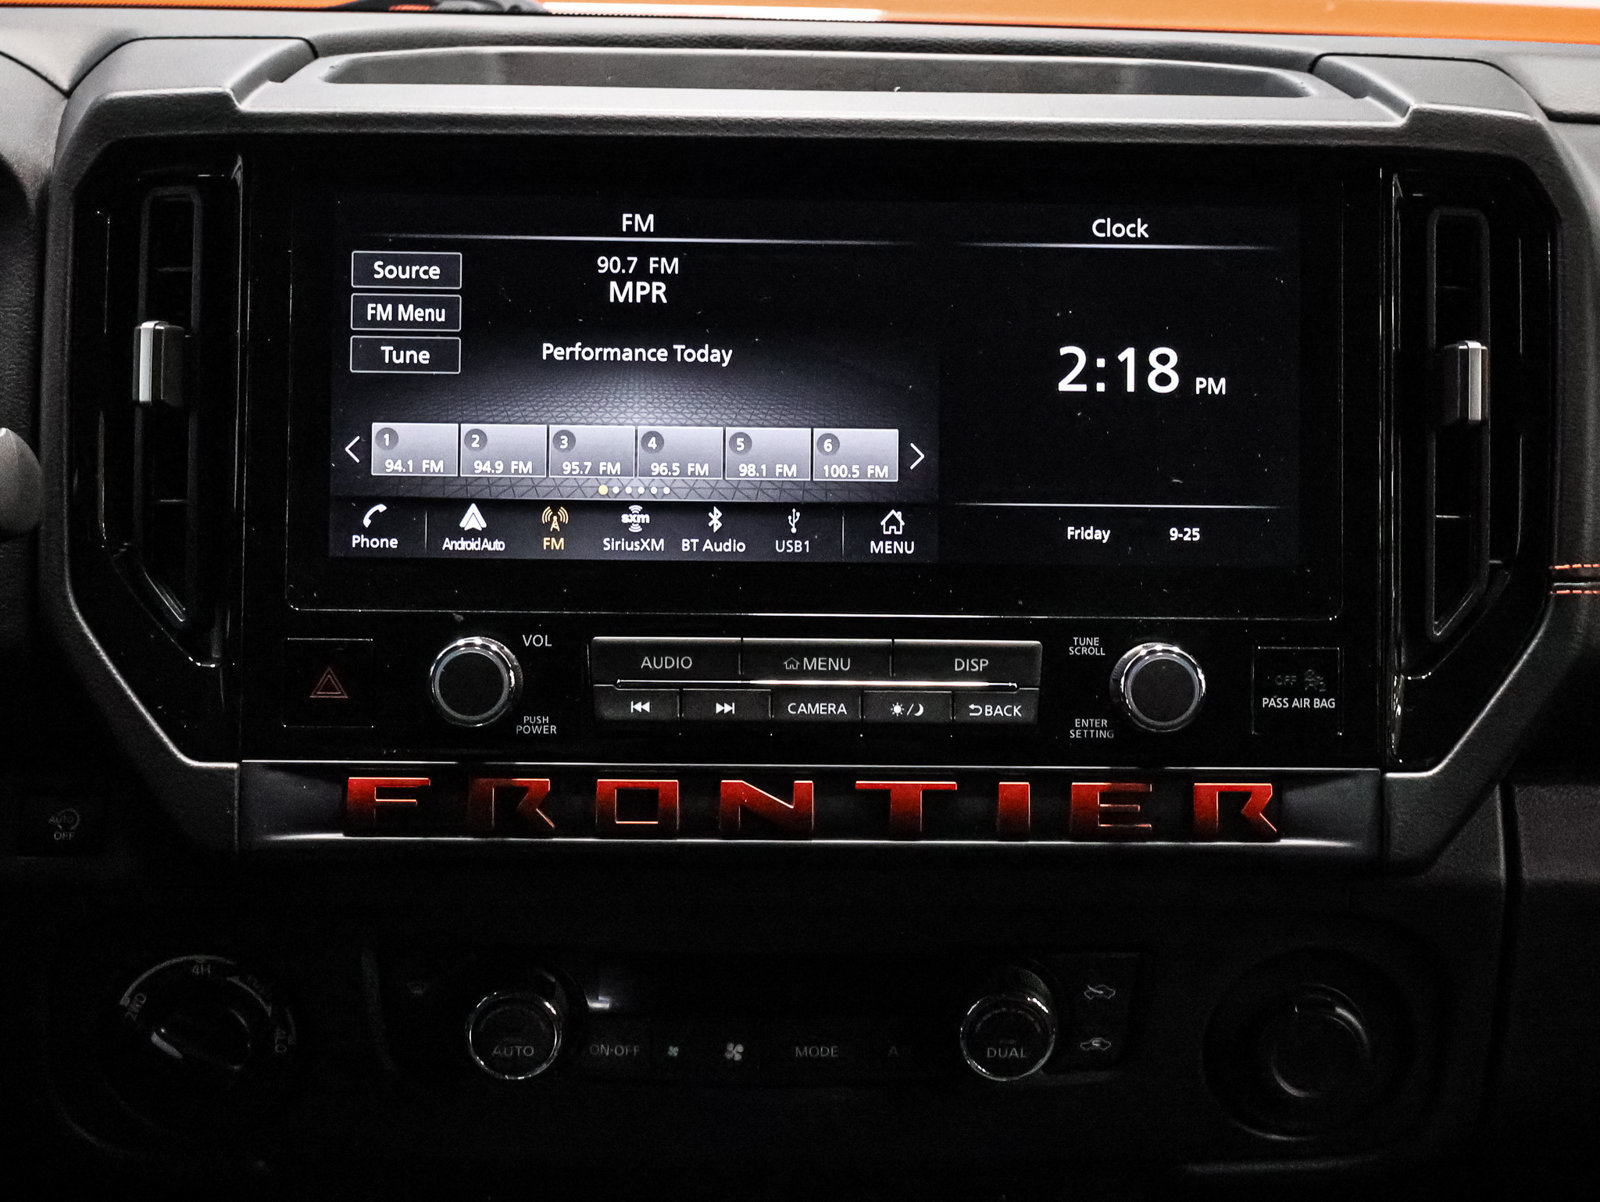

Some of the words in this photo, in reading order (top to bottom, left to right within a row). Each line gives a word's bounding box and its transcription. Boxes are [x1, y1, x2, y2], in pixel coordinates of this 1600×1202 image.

[622, 214, 654, 232] FM
[1092, 218, 1150, 238] Clock
[374, 260, 440, 280] Source
[596, 256, 638, 274] 90.7
[650, 256, 678, 274] FM
[610, 280, 668, 304] MPR
[368, 304, 392, 320] FM
[398, 304, 446, 322] Menu
[380, 346, 430, 364] Tune
[542, 342, 668, 362] Performance
[672, 344, 732, 368] Today
[1058, 346, 1180, 394] 2:18
[1196, 376, 1226, 394] PM
[384, 434, 390, 446] 1
[472, 434, 480, 448] 2
[560, 436, 568, 450] 3
[648, 436, 658, 450] 4
[736, 438, 744, 452] 5
[824, 438, 832, 452] 6
[384, 460, 414, 473] 94.1
[422, 460, 444, 473] FM
[474, 461, 504, 474] 94.9
[510, 461, 532, 474] FM
[562, 462, 592, 475] 95.7
[599, 462, 621, 475] FM
[650, 463, 680, 476] 96.5
[688, 464, 710, 476] FM
[738, 464, 767, 477] 98.1
[775, 464, 797, 478] FM
[823, 465, 860, 478] 100.5
[867, 466, 889, 479] FM
[352, 534, 398, 548] Phone
[1068, 526, 1110, 544] Friday
[1170, 528, 1200, 542] 9-25
[442, 537, 481, 550] Android
[481, 538, 506, 550] Auto
[544, 538, 564, 550] FM
[602, 538, 665, 552] SiriusXM
[682, 538, 700, 552] BT
[702, 538, 746, 552] Audio
[776, 540, 810, 552] USB1
[870, 540, 914, 554] MENU
[522, 634, 552, 646] VOL
[1072, 636, 1100, 646] TUNE
[1068, 646, 1106, 656] SCROLL
[640, 656, 692, 670] AUDIO
[804, 658, 850, 670] MENU
[954, 658, 988, 672] DISP
[788, 702, 848, 714] CAMERA
[1262, 698, 1289, 709] PASS
[1292, 698, 1310, 709] AIR
[1313, 698, 1336, 709] BAG
[984, 704, 1022, 718] BACK
[524, 716, 548, 726] PUSH
[1074, 718, 1108, 728] ENTER
[516, 724, 556, 734] POWER
[1070, 728, 1114, 740] SETTING
[346, 777, 1279, 839] FRONTIER
[491, 1045, 534, 1057] AUTO
[795, 1045, 838, 1058] MODE
[986, 1047, 1028, 1059] DUAL
